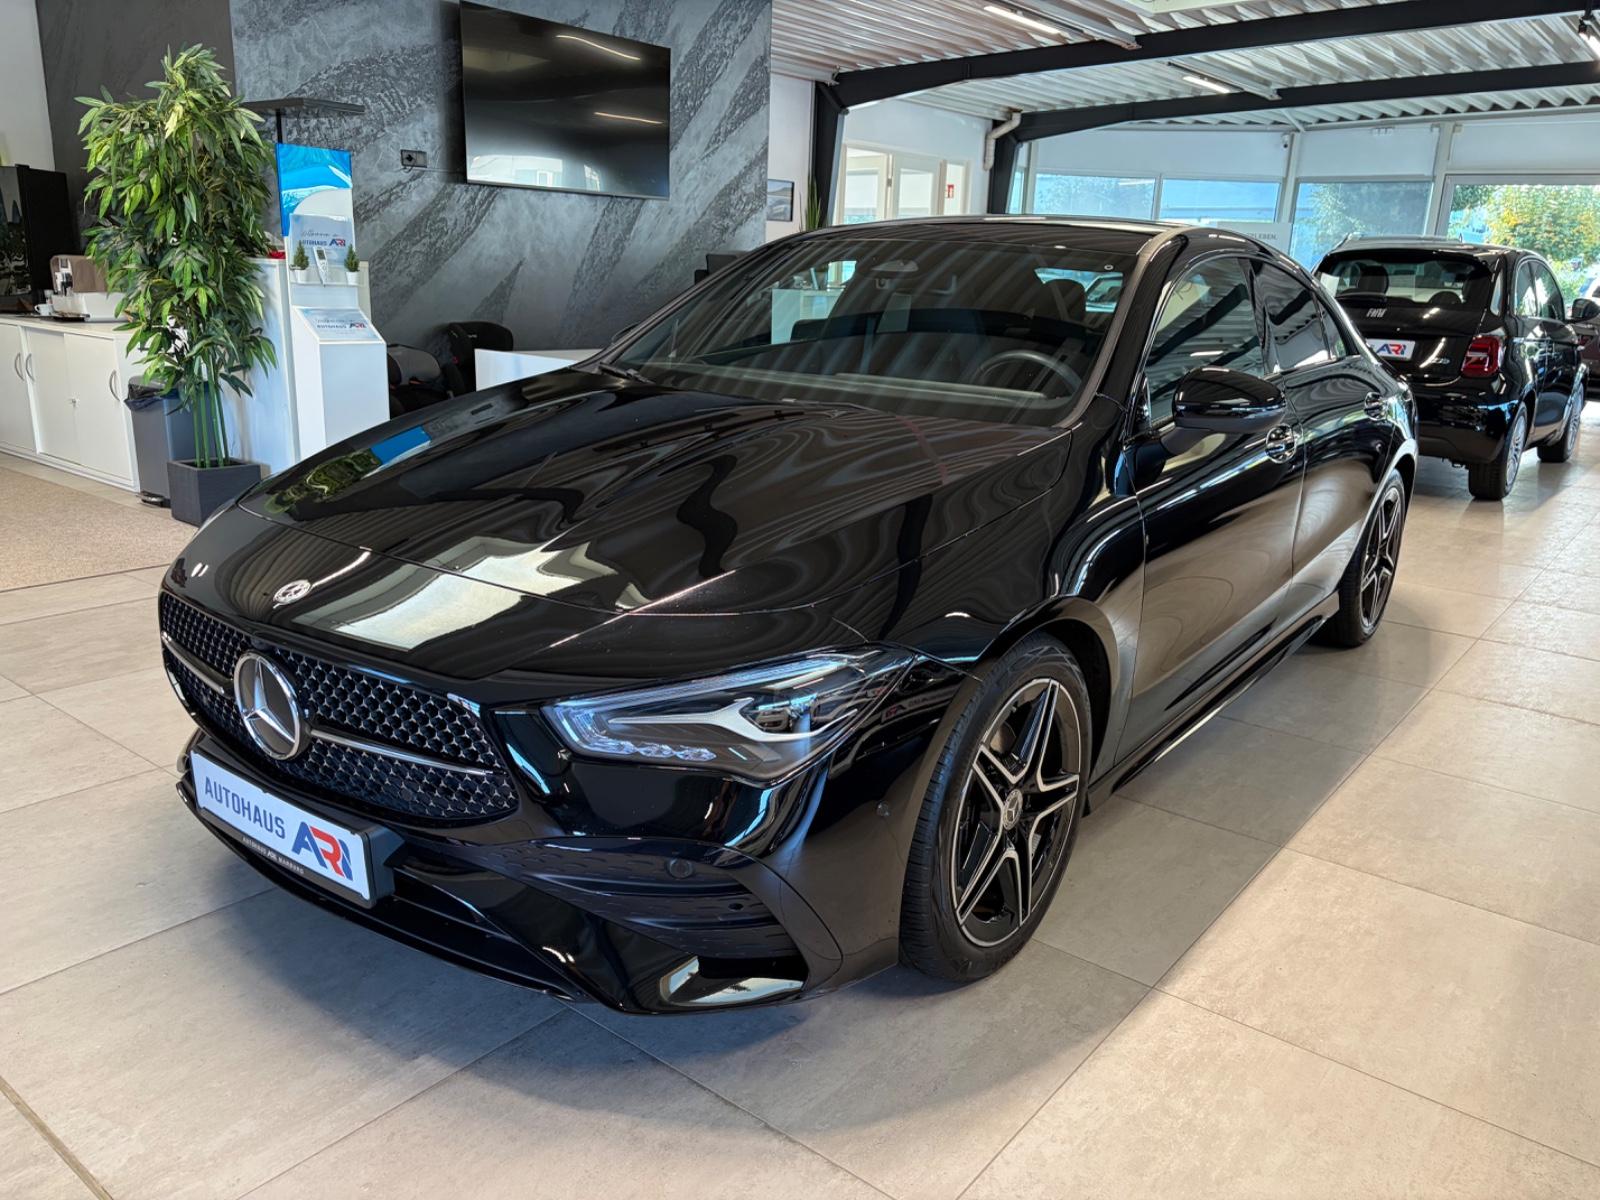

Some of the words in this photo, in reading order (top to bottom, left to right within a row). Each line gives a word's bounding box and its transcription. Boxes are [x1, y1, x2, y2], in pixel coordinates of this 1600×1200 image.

[329, 238, 346, 246] ARI
[1376, 343, 1406, 355] ARI
[205, 776, 285, 839] AUTOHAUS
[291, 821, 353, 881] ARI
